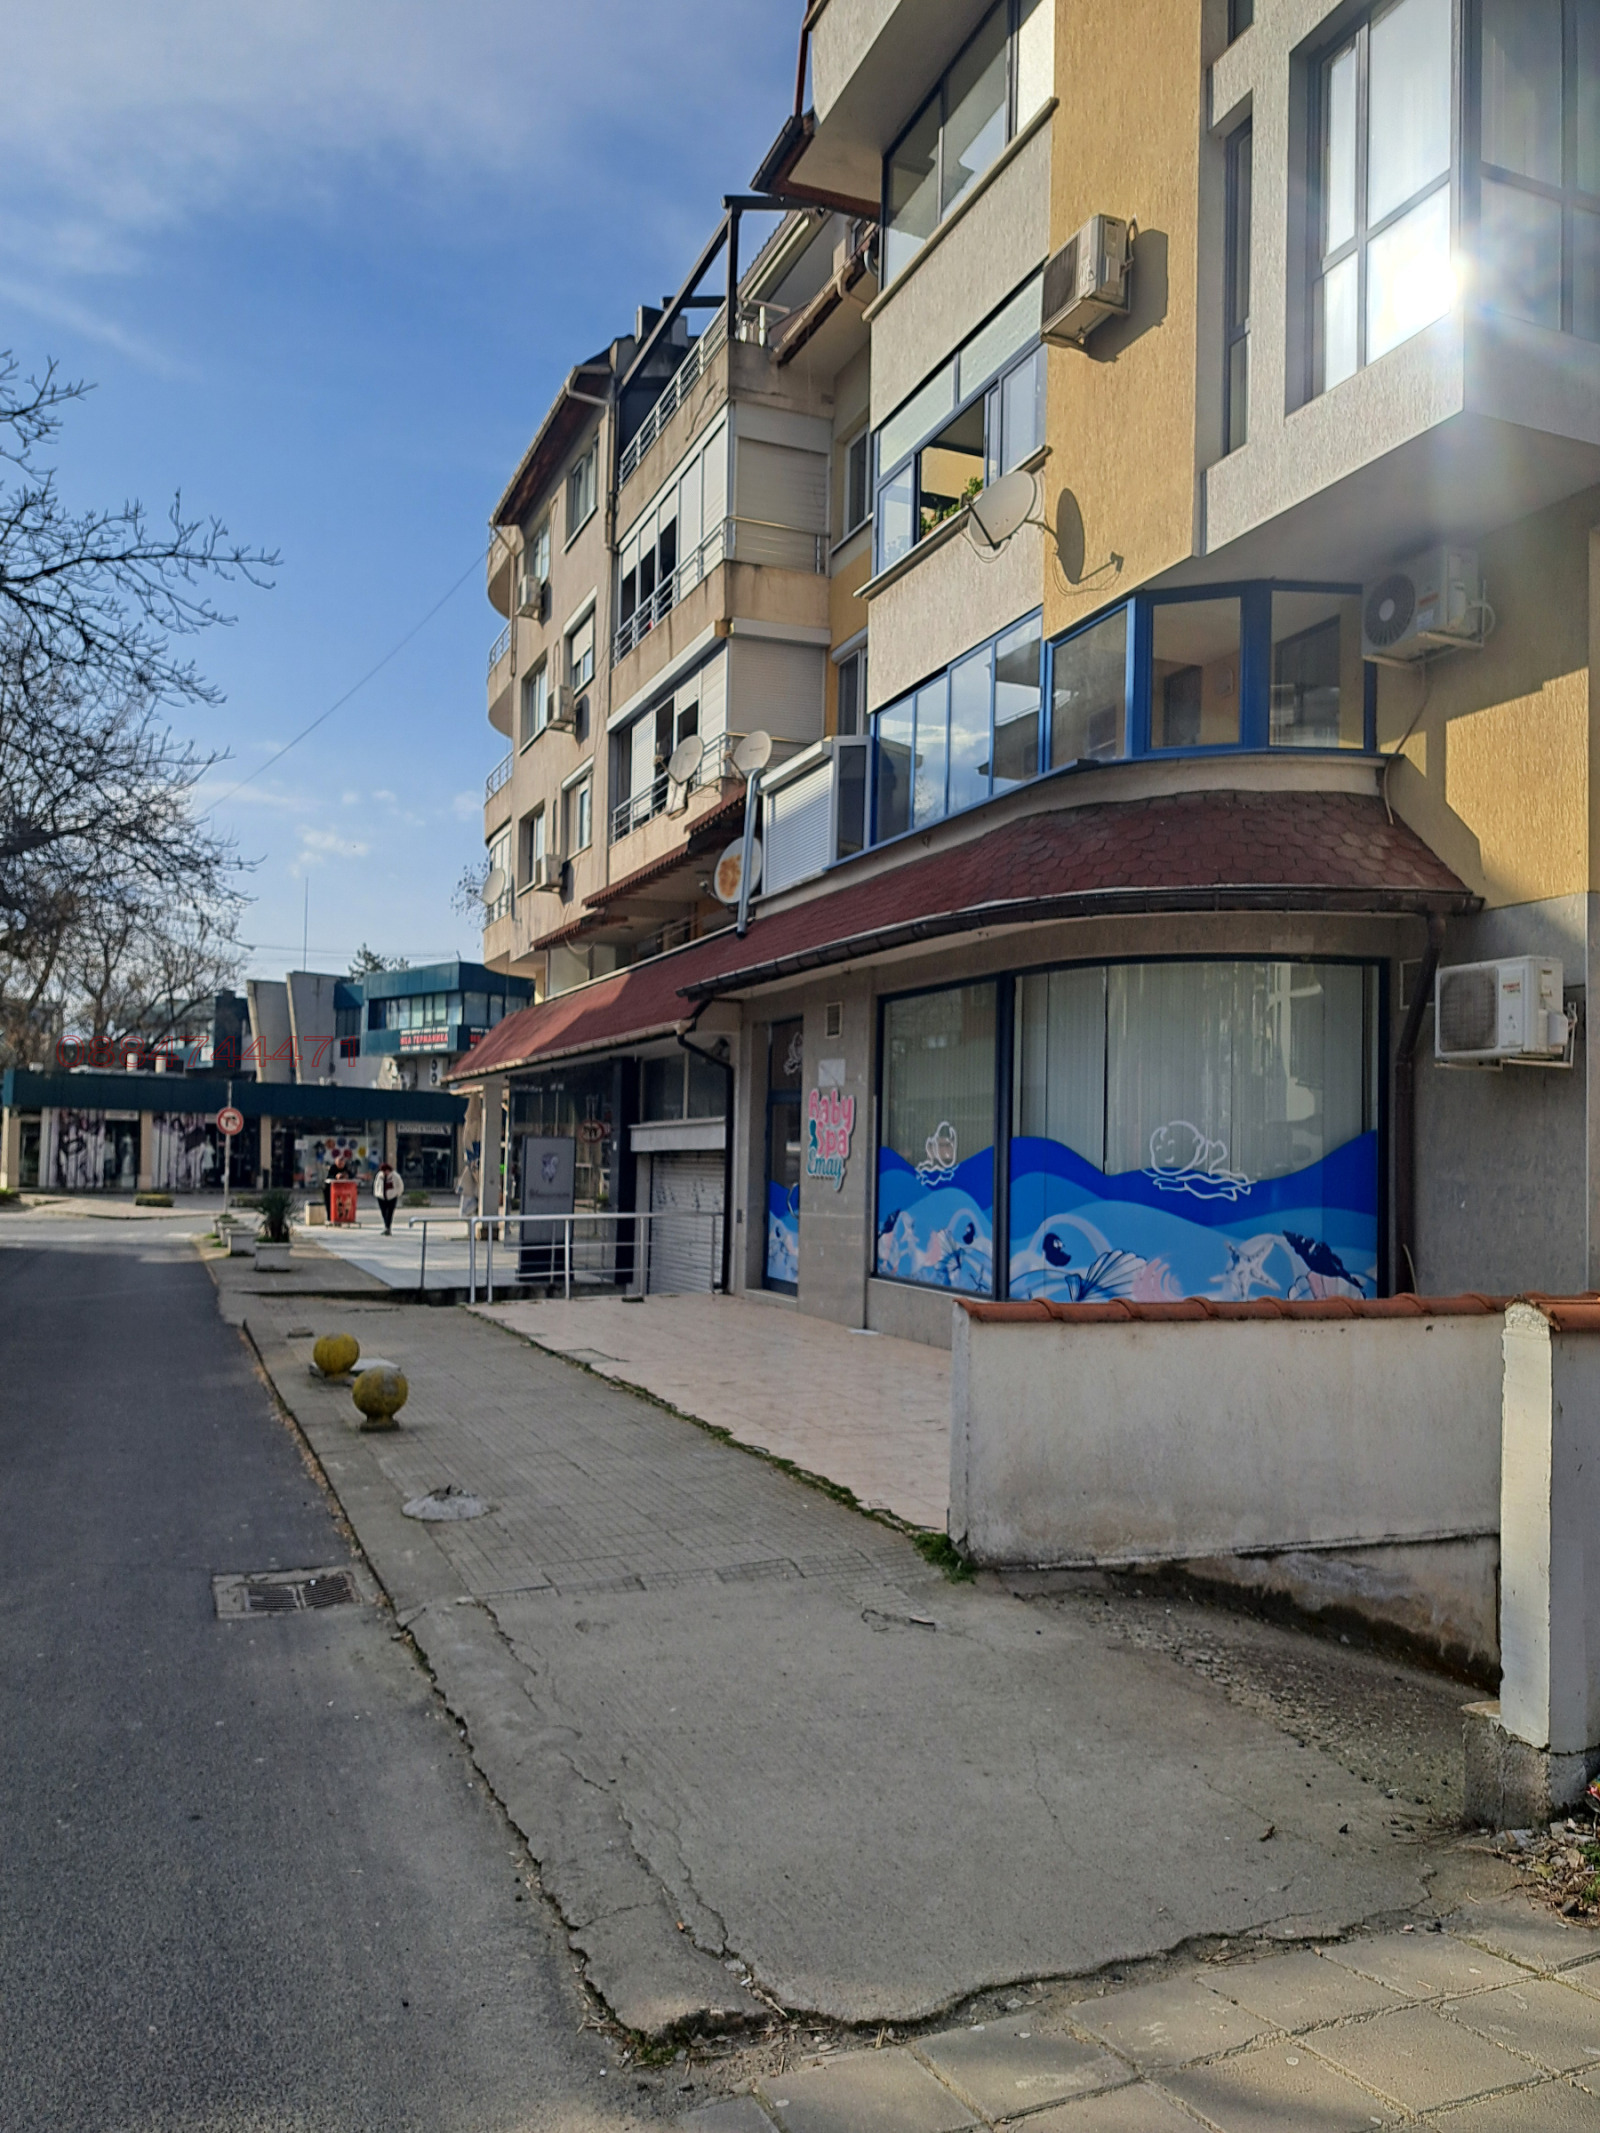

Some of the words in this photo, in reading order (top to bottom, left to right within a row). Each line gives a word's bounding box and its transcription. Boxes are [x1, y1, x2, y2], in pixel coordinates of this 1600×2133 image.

[809, 1090, 854, 1132] Baby
[817, 1121, 847, 1159] Spa
[808, 1148, 842, 1189] Emay
